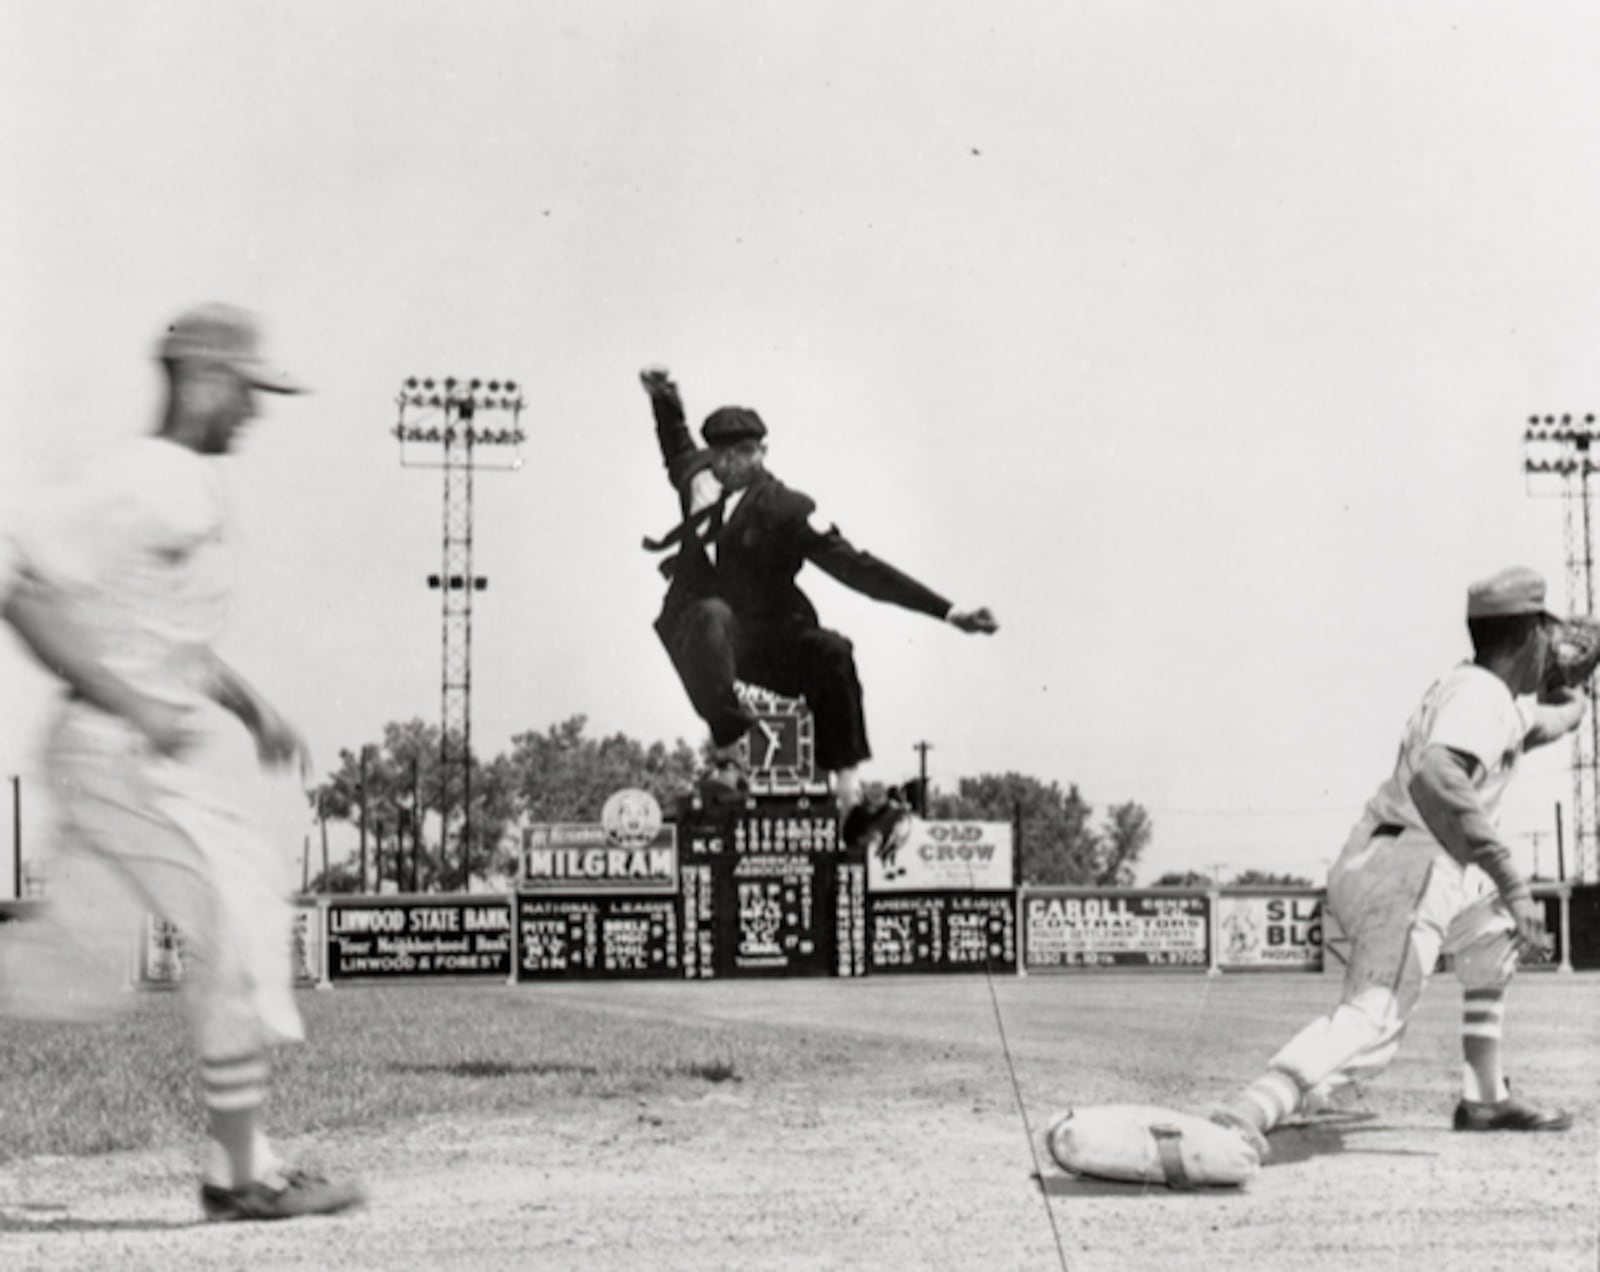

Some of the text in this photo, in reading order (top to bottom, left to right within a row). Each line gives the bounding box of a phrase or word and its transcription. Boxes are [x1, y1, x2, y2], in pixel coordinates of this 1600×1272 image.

[927, 826, 983, 842] OLD
[918, 845, 995, 861] CROW
[530, 849, 672, 877] MILGRAM
[522, 901, 674, 913] NATIONAL LEAGUE
[873, 898, 944, 910] AMERICAN
[1029, 899, 1135, 918] CAROLL
[331, 907, 510, 933] LINWOOD STATE BANK
[1031, 918, 1200, 928] CONTRACTORS
[340, 957, 416, 971] LINWOOD
[434, 954, 502, 969] FOREST
